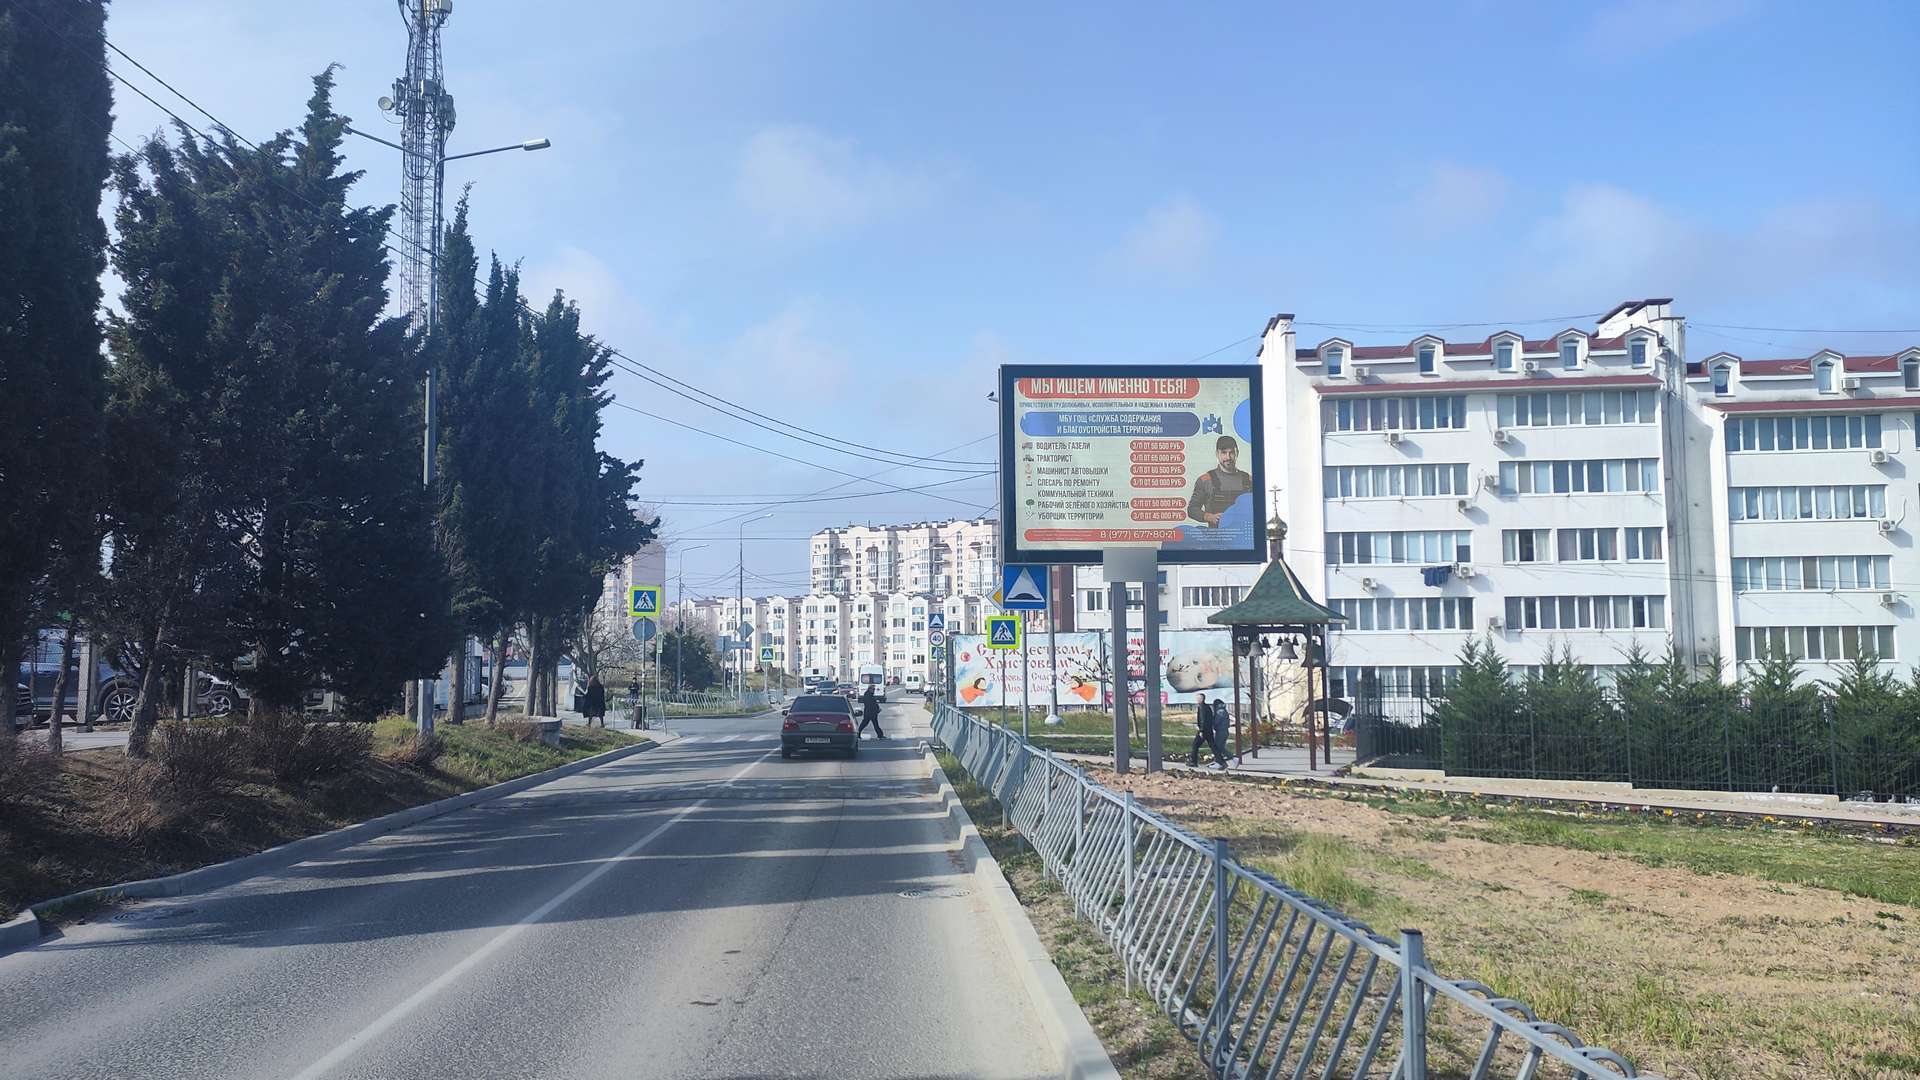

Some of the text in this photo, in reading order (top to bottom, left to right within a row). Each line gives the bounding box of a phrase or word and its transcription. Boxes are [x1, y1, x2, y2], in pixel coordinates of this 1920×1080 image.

[1031, 378, 1187, 395] МЫ ИЩЕМ ИМЕННО ТЕБЯ!
[1120, 415, 1161, 424] СОДЕРЖАНИЯ
[1036, 442, 1067, 450] ВОДИТЕЛЬ
[1038, 489, 1086, 497] КОММУНАЛЬНОЙ
[1038, 500, 1064, 509] РАБОЧИЙ
[1097, 501, 1129, 509] ХОЗЯЙСТВА
[1100, 530, 1106, 538] 8
[1108, 530, 1131, 539] (977)
